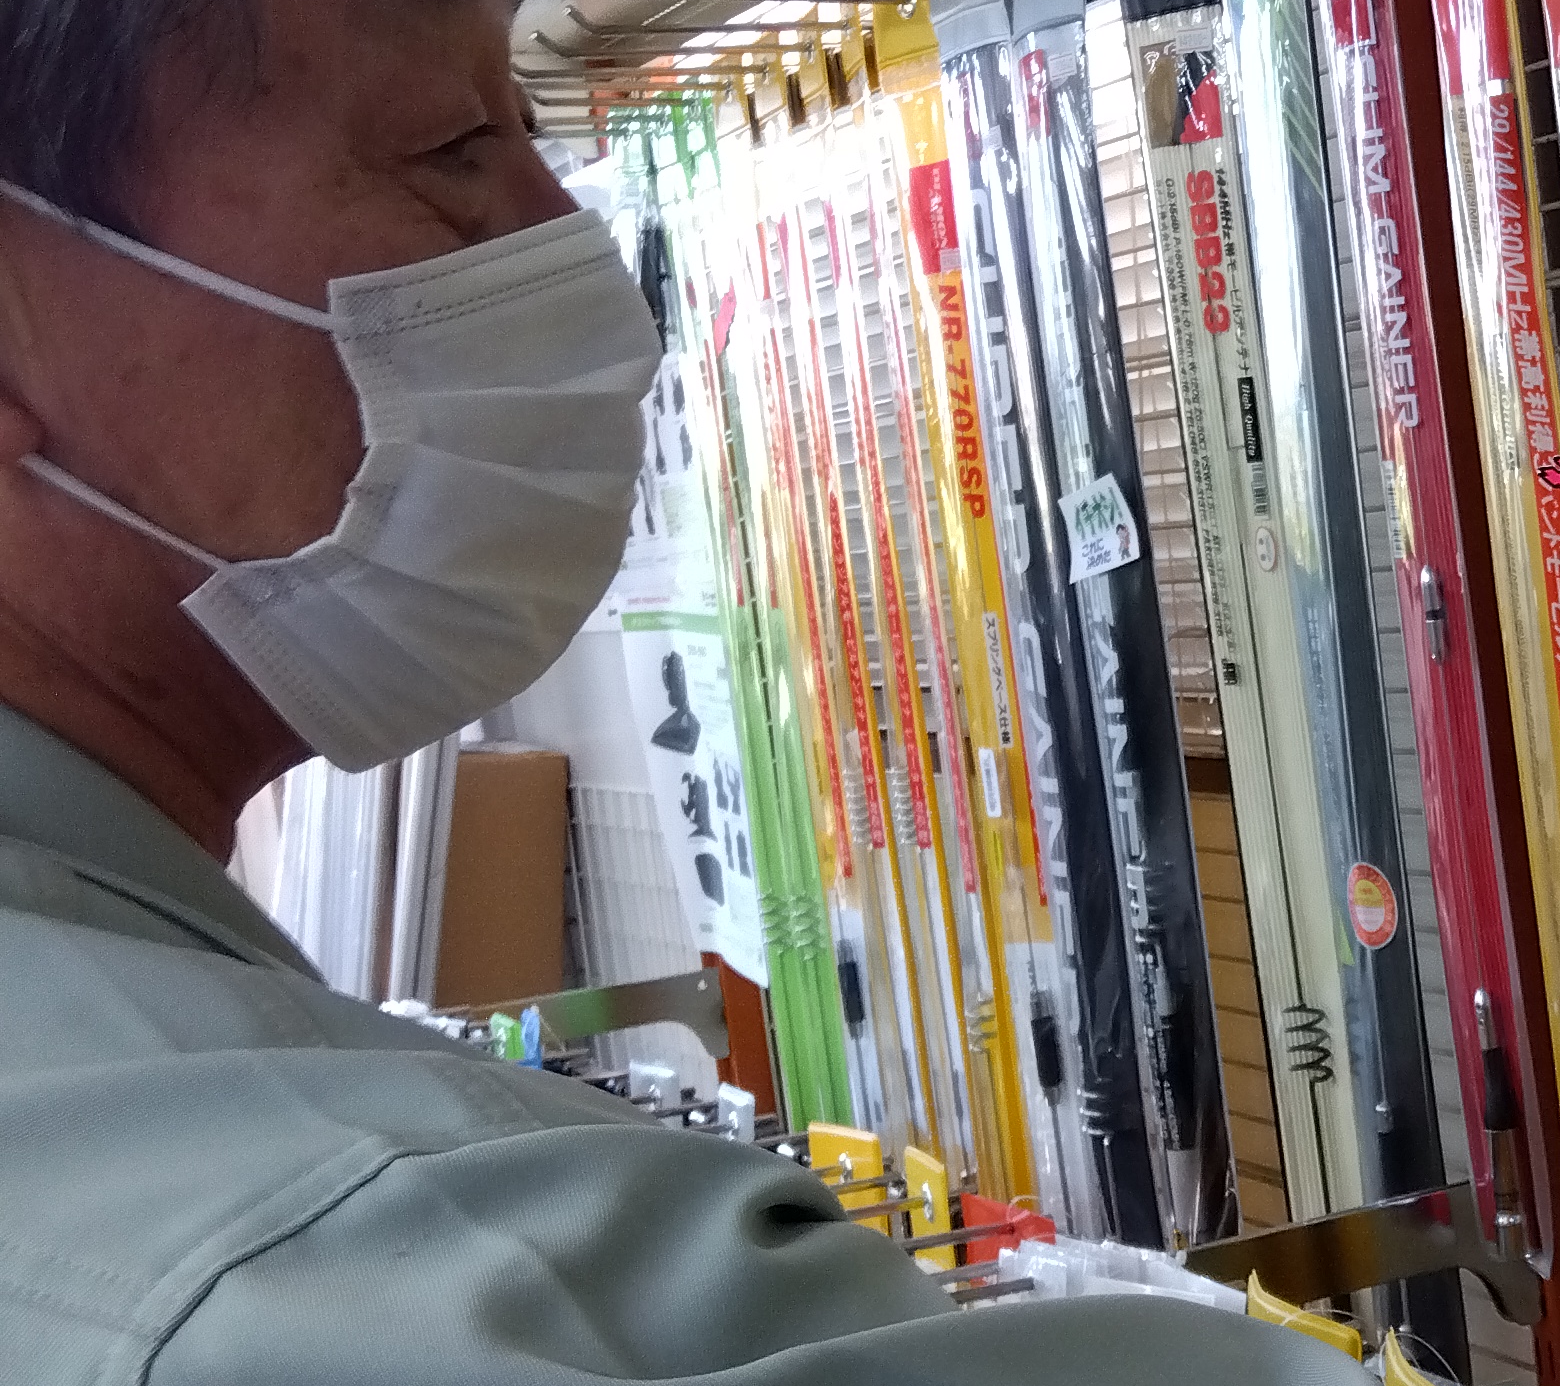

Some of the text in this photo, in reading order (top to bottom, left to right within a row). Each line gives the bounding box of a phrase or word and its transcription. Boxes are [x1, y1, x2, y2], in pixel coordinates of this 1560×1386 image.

[1186, 169, 1232, 335] SBB23
[1373, 217, 1420, 430] GAINER
[938, 283, 987, 520] NR-770RSP
[1239, 383, 1257, 457] High Quality
[985, 616, 1012, 745] スプリングベース仕様
